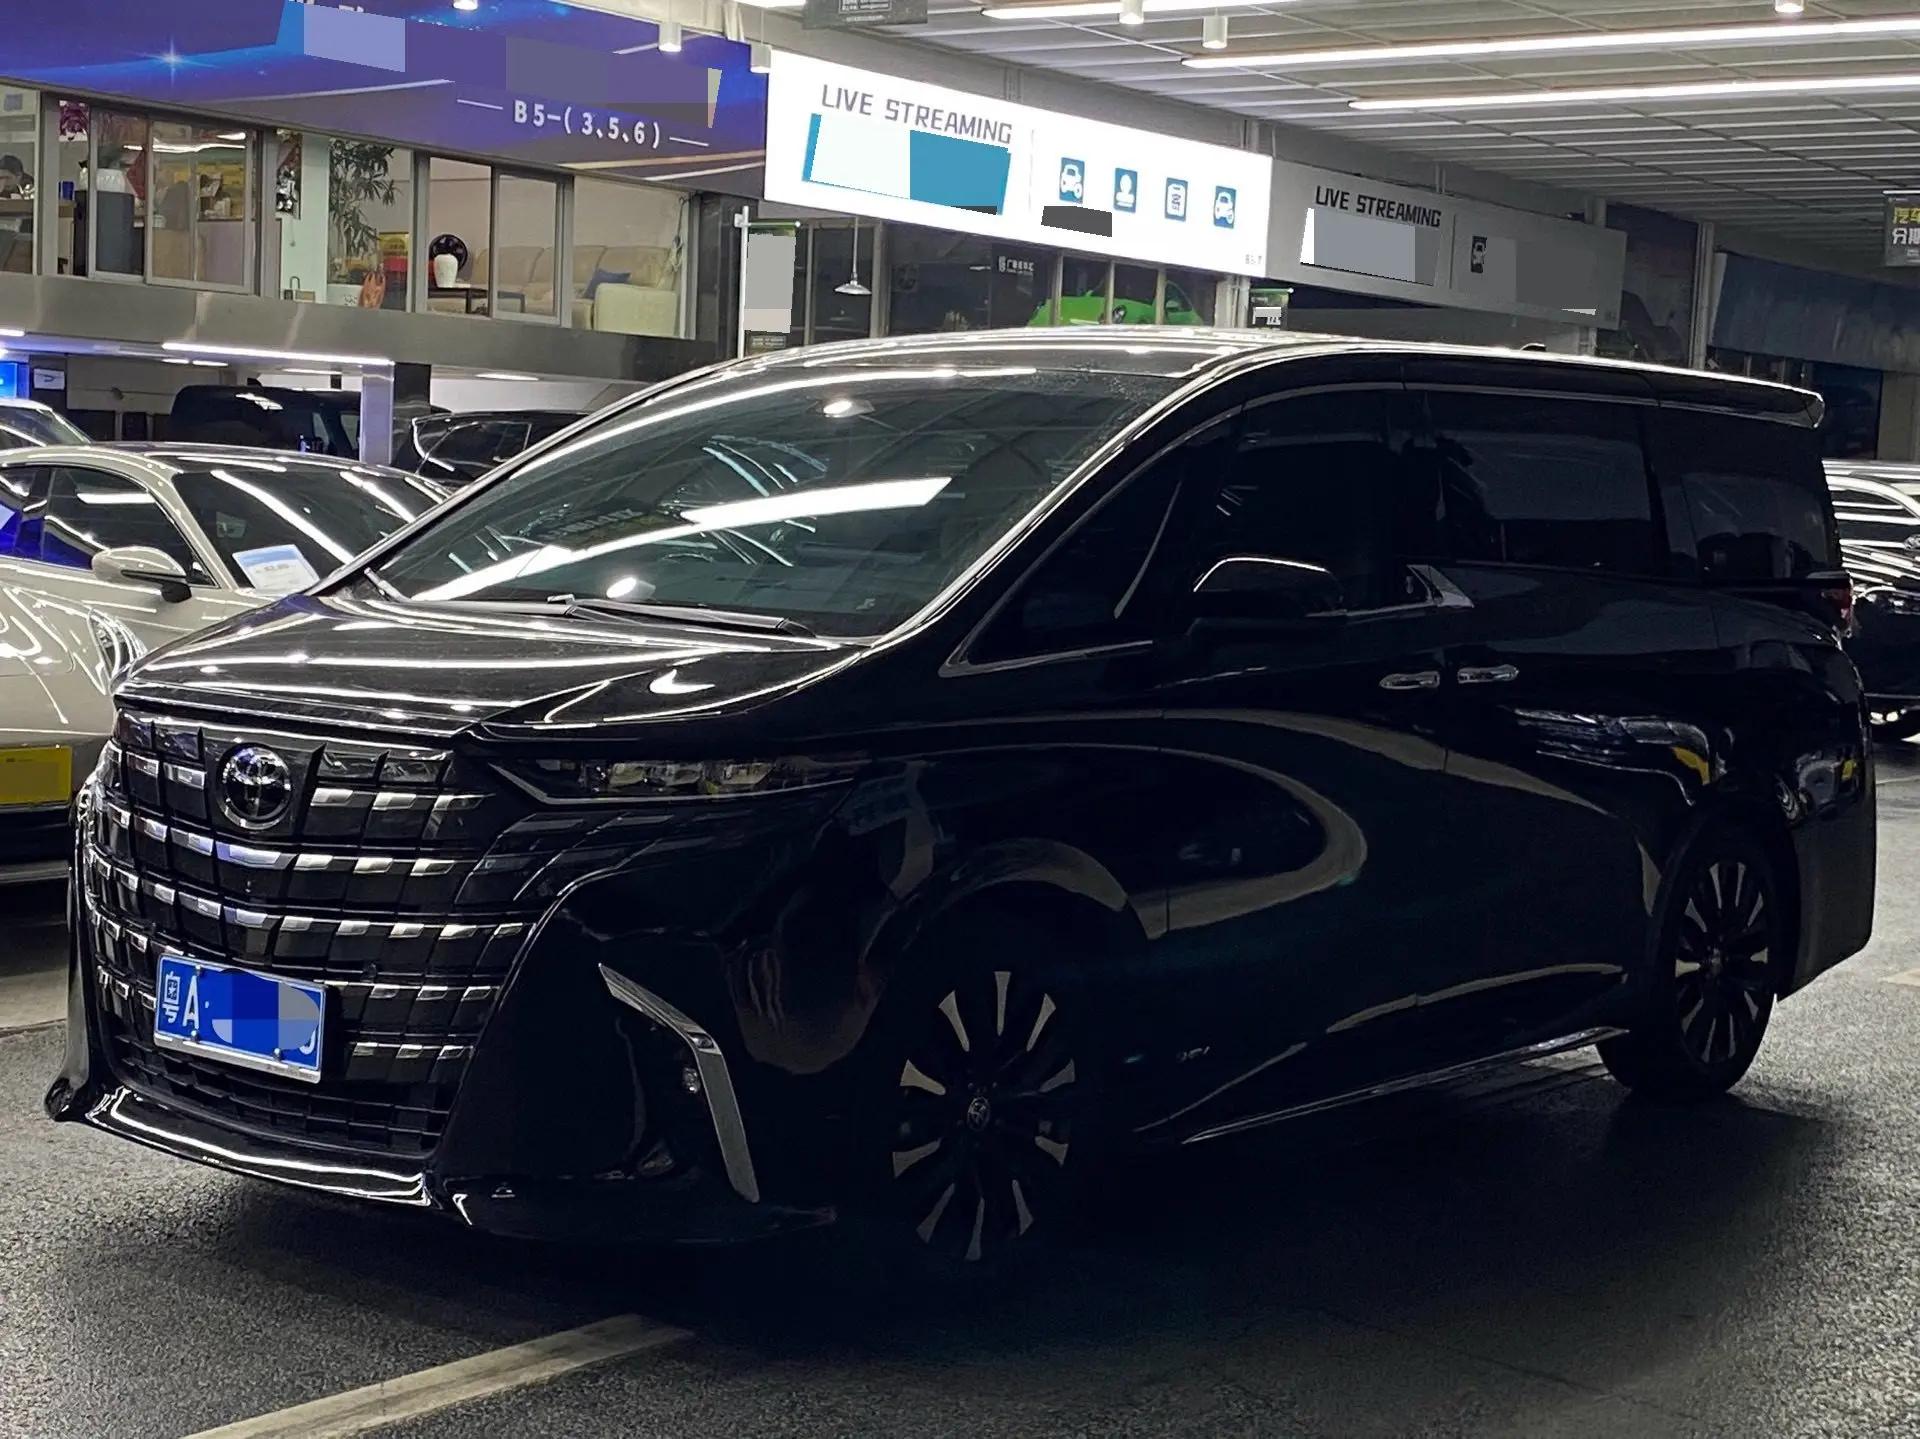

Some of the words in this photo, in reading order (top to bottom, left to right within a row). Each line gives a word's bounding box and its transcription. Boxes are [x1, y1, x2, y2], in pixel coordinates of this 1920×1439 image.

[821, 84, 873, 116] LIVE
[884, 98, 1012, 144] STREAMING
[1315, 185, 1350, 211] LIVE
[1356, 194, 1442, 228] STREAMING
